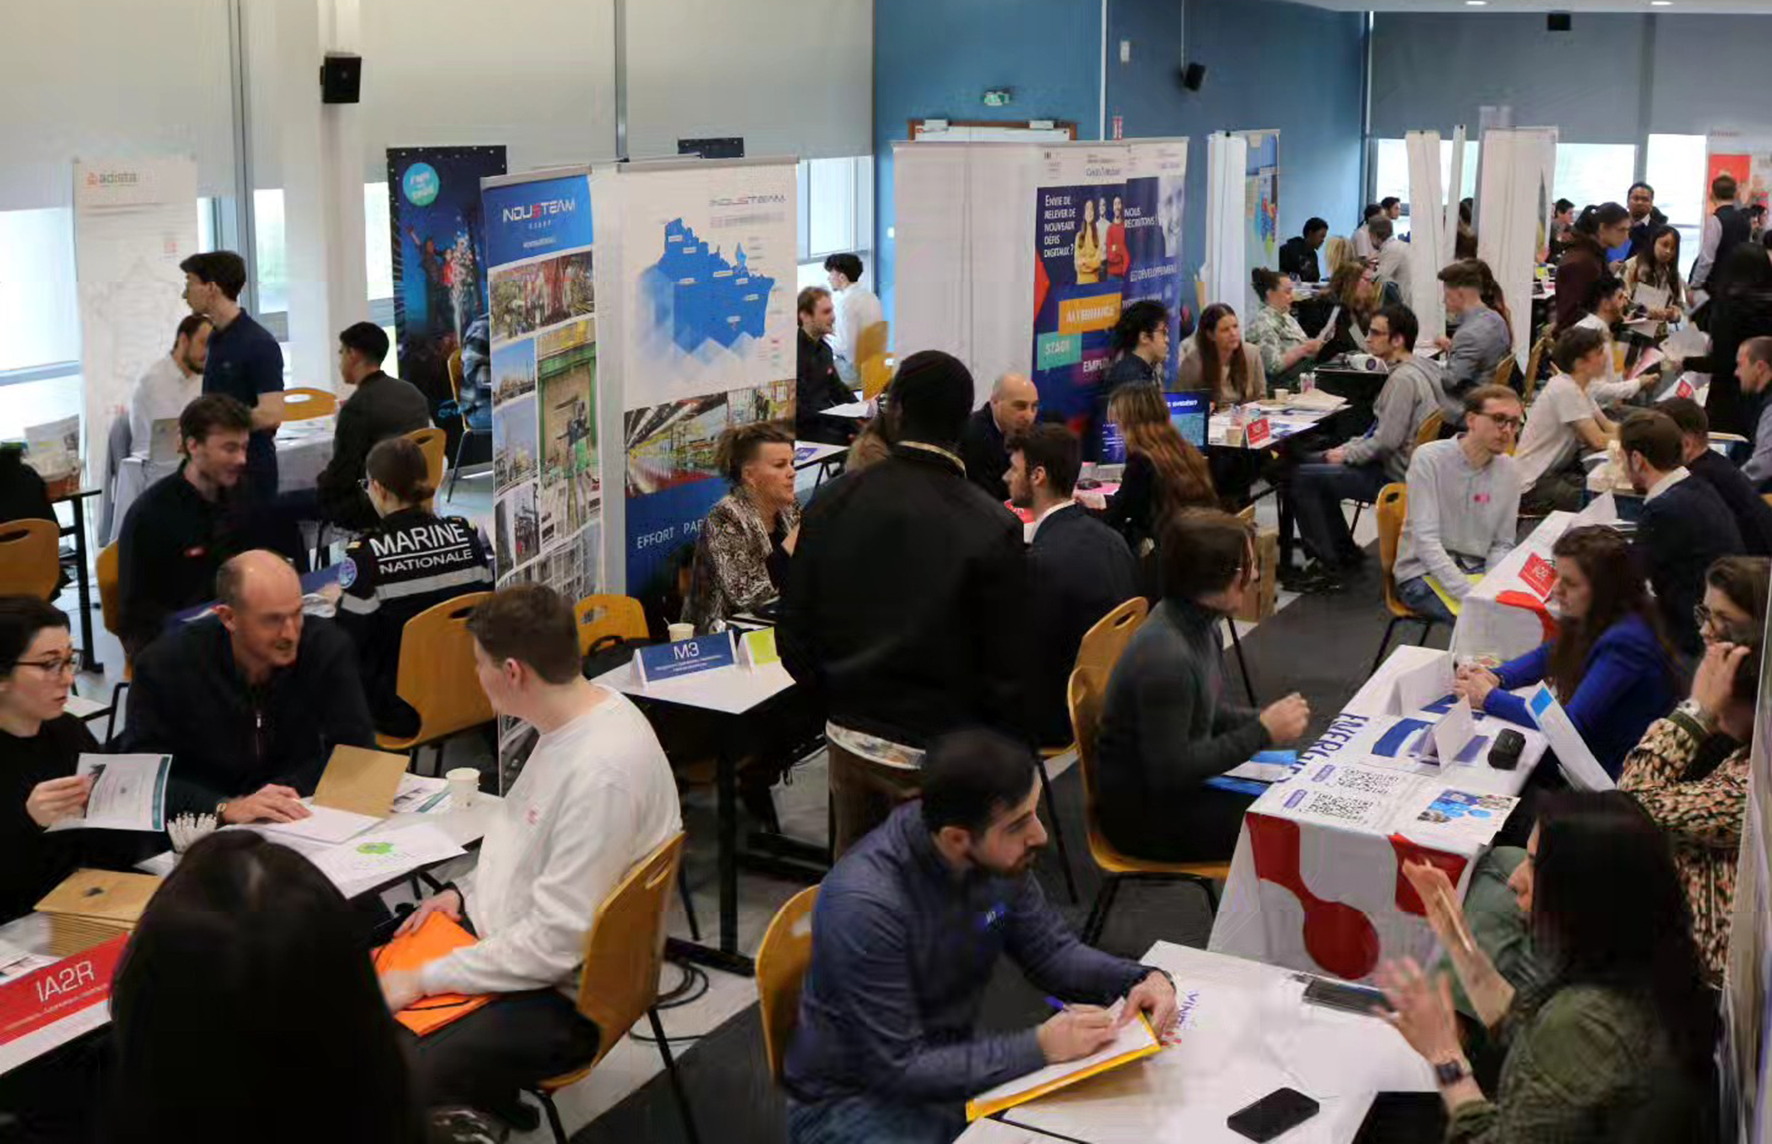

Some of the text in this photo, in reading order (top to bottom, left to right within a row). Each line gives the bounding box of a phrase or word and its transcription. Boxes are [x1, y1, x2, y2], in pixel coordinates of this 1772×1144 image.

[1044, 209, 1068, 219] RELEVER
[1044, 221, 1075, 232] NOUVEAUX
[369, 523, 469, 556] MARINE
[637, 526, 676, 549] EFFORT
[379, 549, 473, 574] NATIONALE
[673, 641, 700, 661] M3
[36, 960, 95, 1003] IA2R
